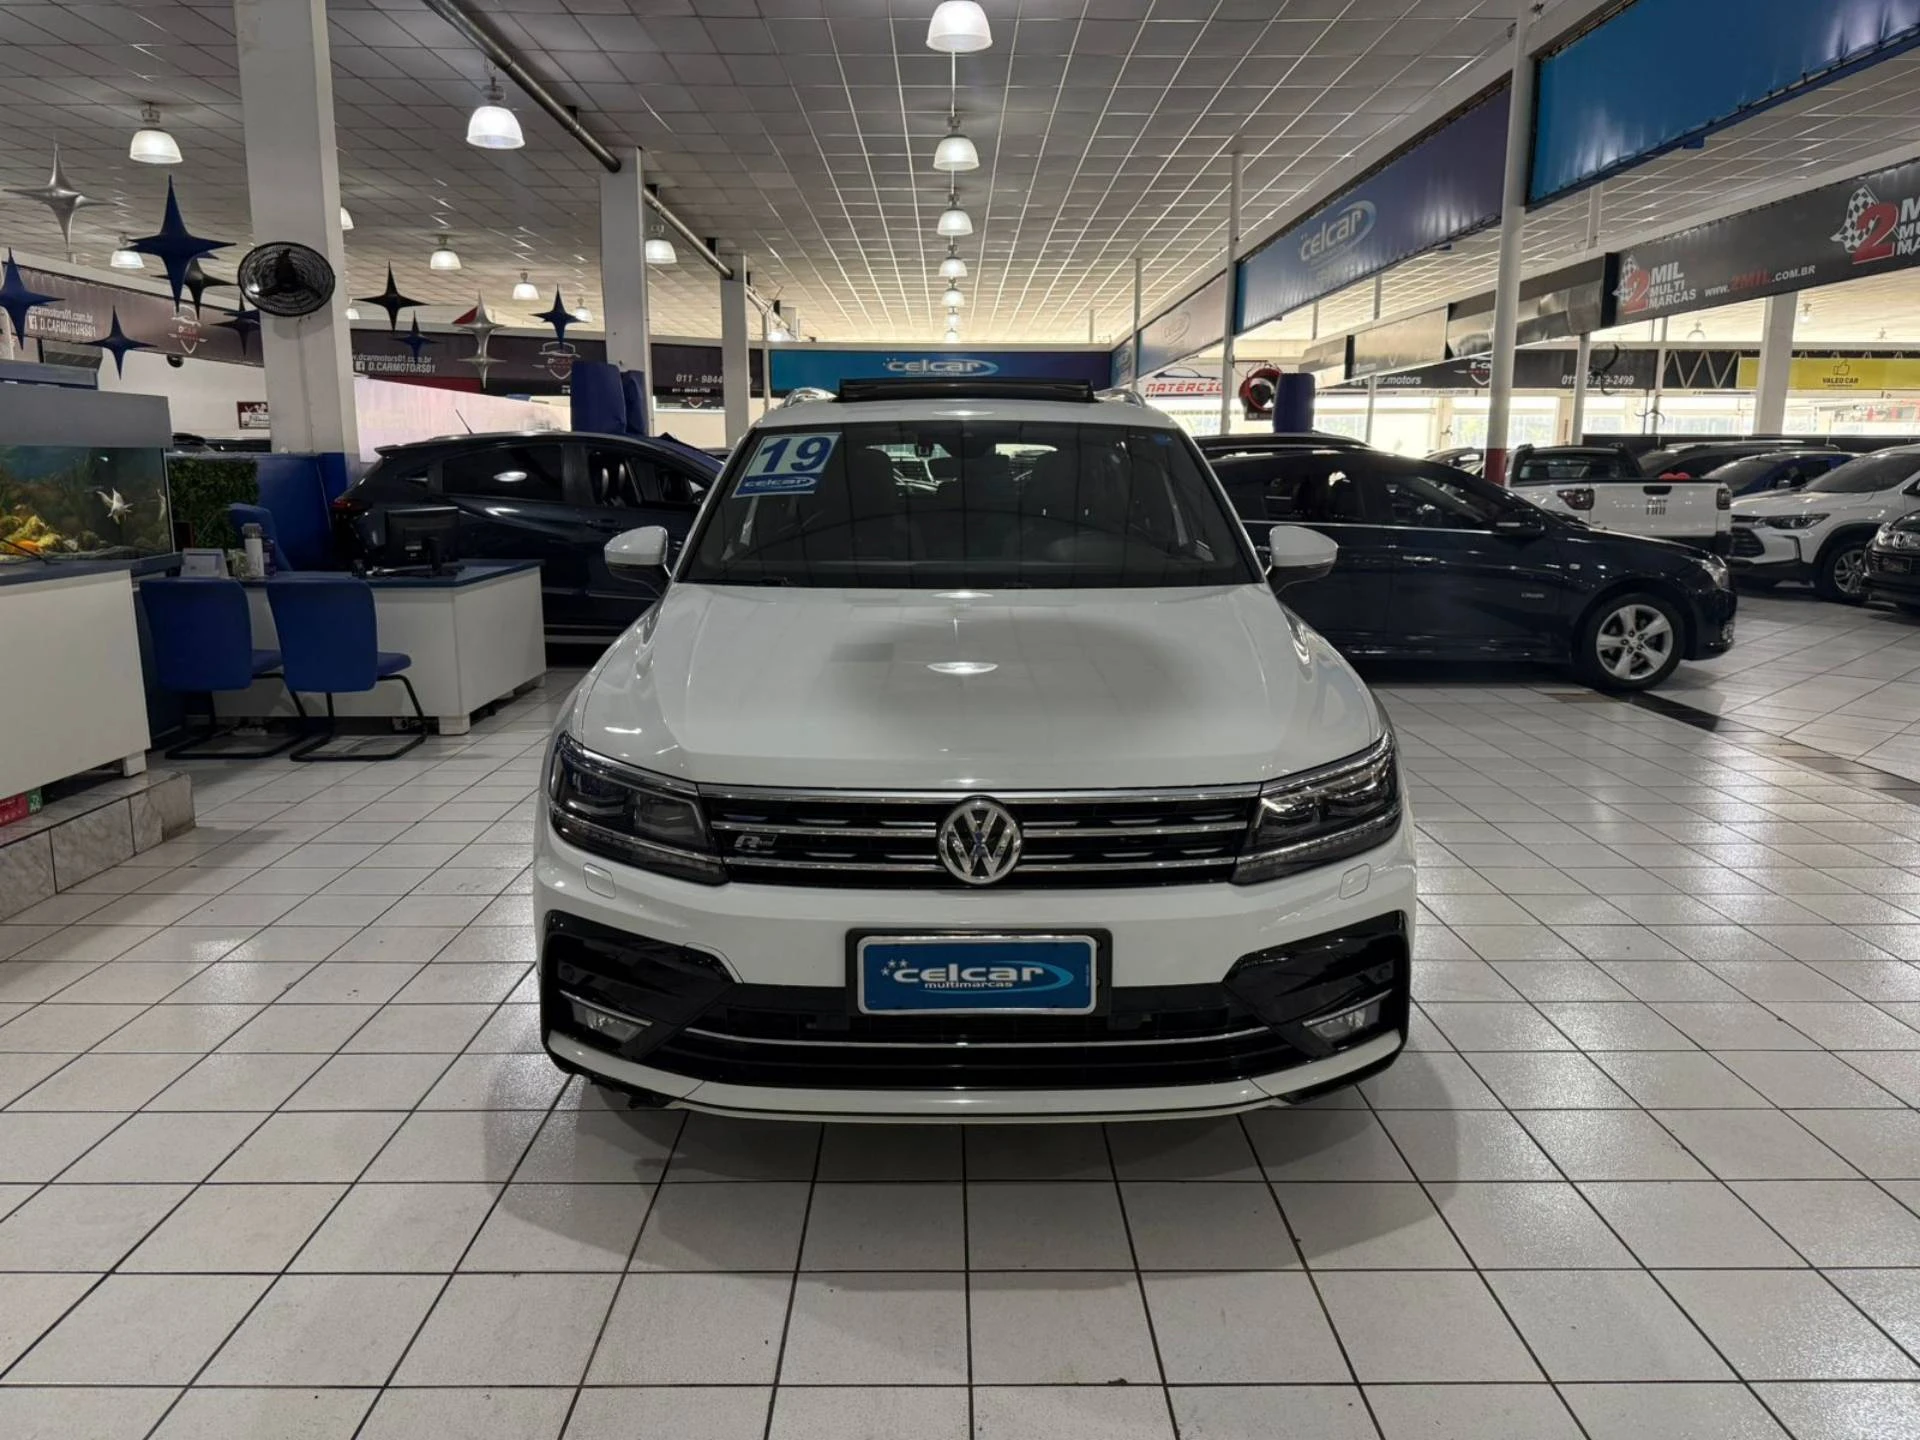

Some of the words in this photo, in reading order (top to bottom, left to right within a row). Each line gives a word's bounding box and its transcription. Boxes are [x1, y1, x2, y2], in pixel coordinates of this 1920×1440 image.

[1300, 210, 1363, 261] celcar
[1651, 262, 1684, 285] MIL
[1649, 288, 1697, 308] MARCAS
[1650, 279, 1685, 298] MULTI
[887, 359, 981, 372] celcar
[676, 373, 693, 383] 011
[760, 437, 832, 473] 19
[894, 963, 1044, 983] celcar
[924, 980, 1014, 989] multimarcas
